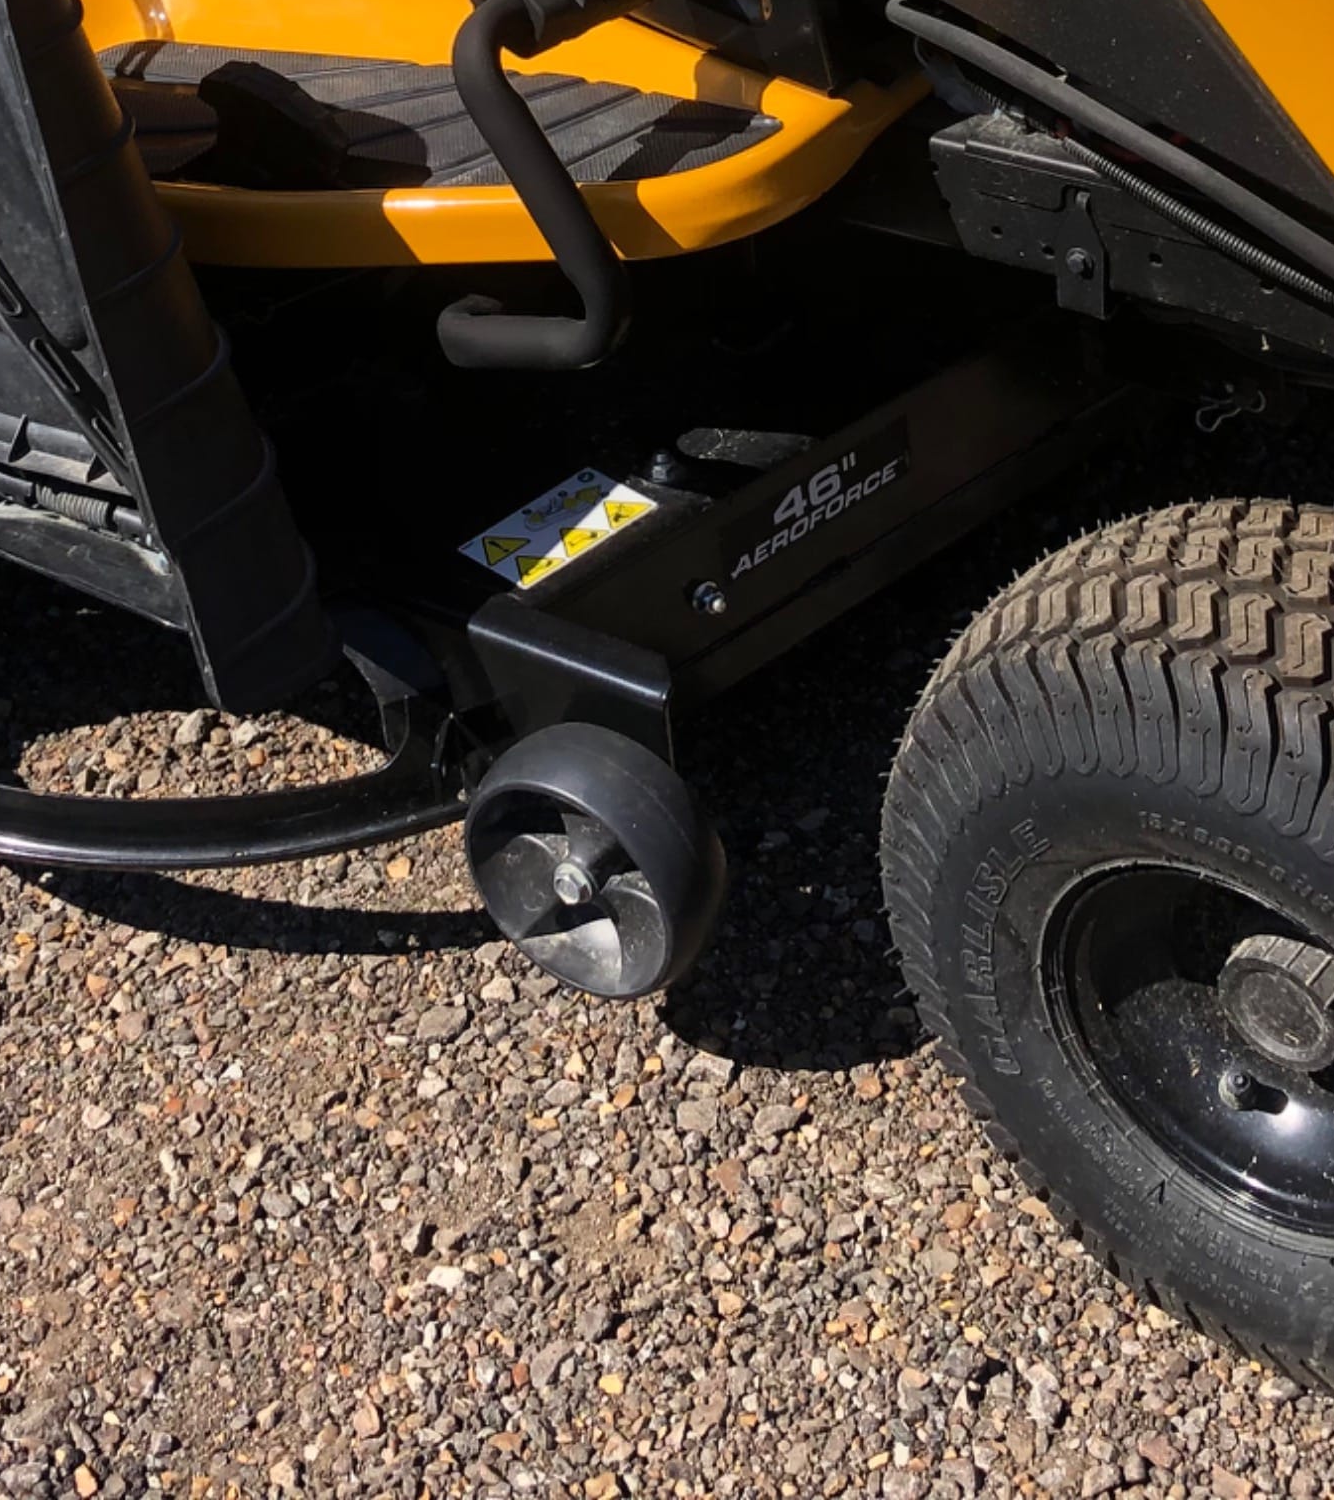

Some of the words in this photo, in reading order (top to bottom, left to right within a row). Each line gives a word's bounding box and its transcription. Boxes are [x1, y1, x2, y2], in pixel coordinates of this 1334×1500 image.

[730, 458, 899, 580] AEROFORCE
[773, 451, 857, 526] 46"
[961, 817, 1054, 1076] CARLISLE
